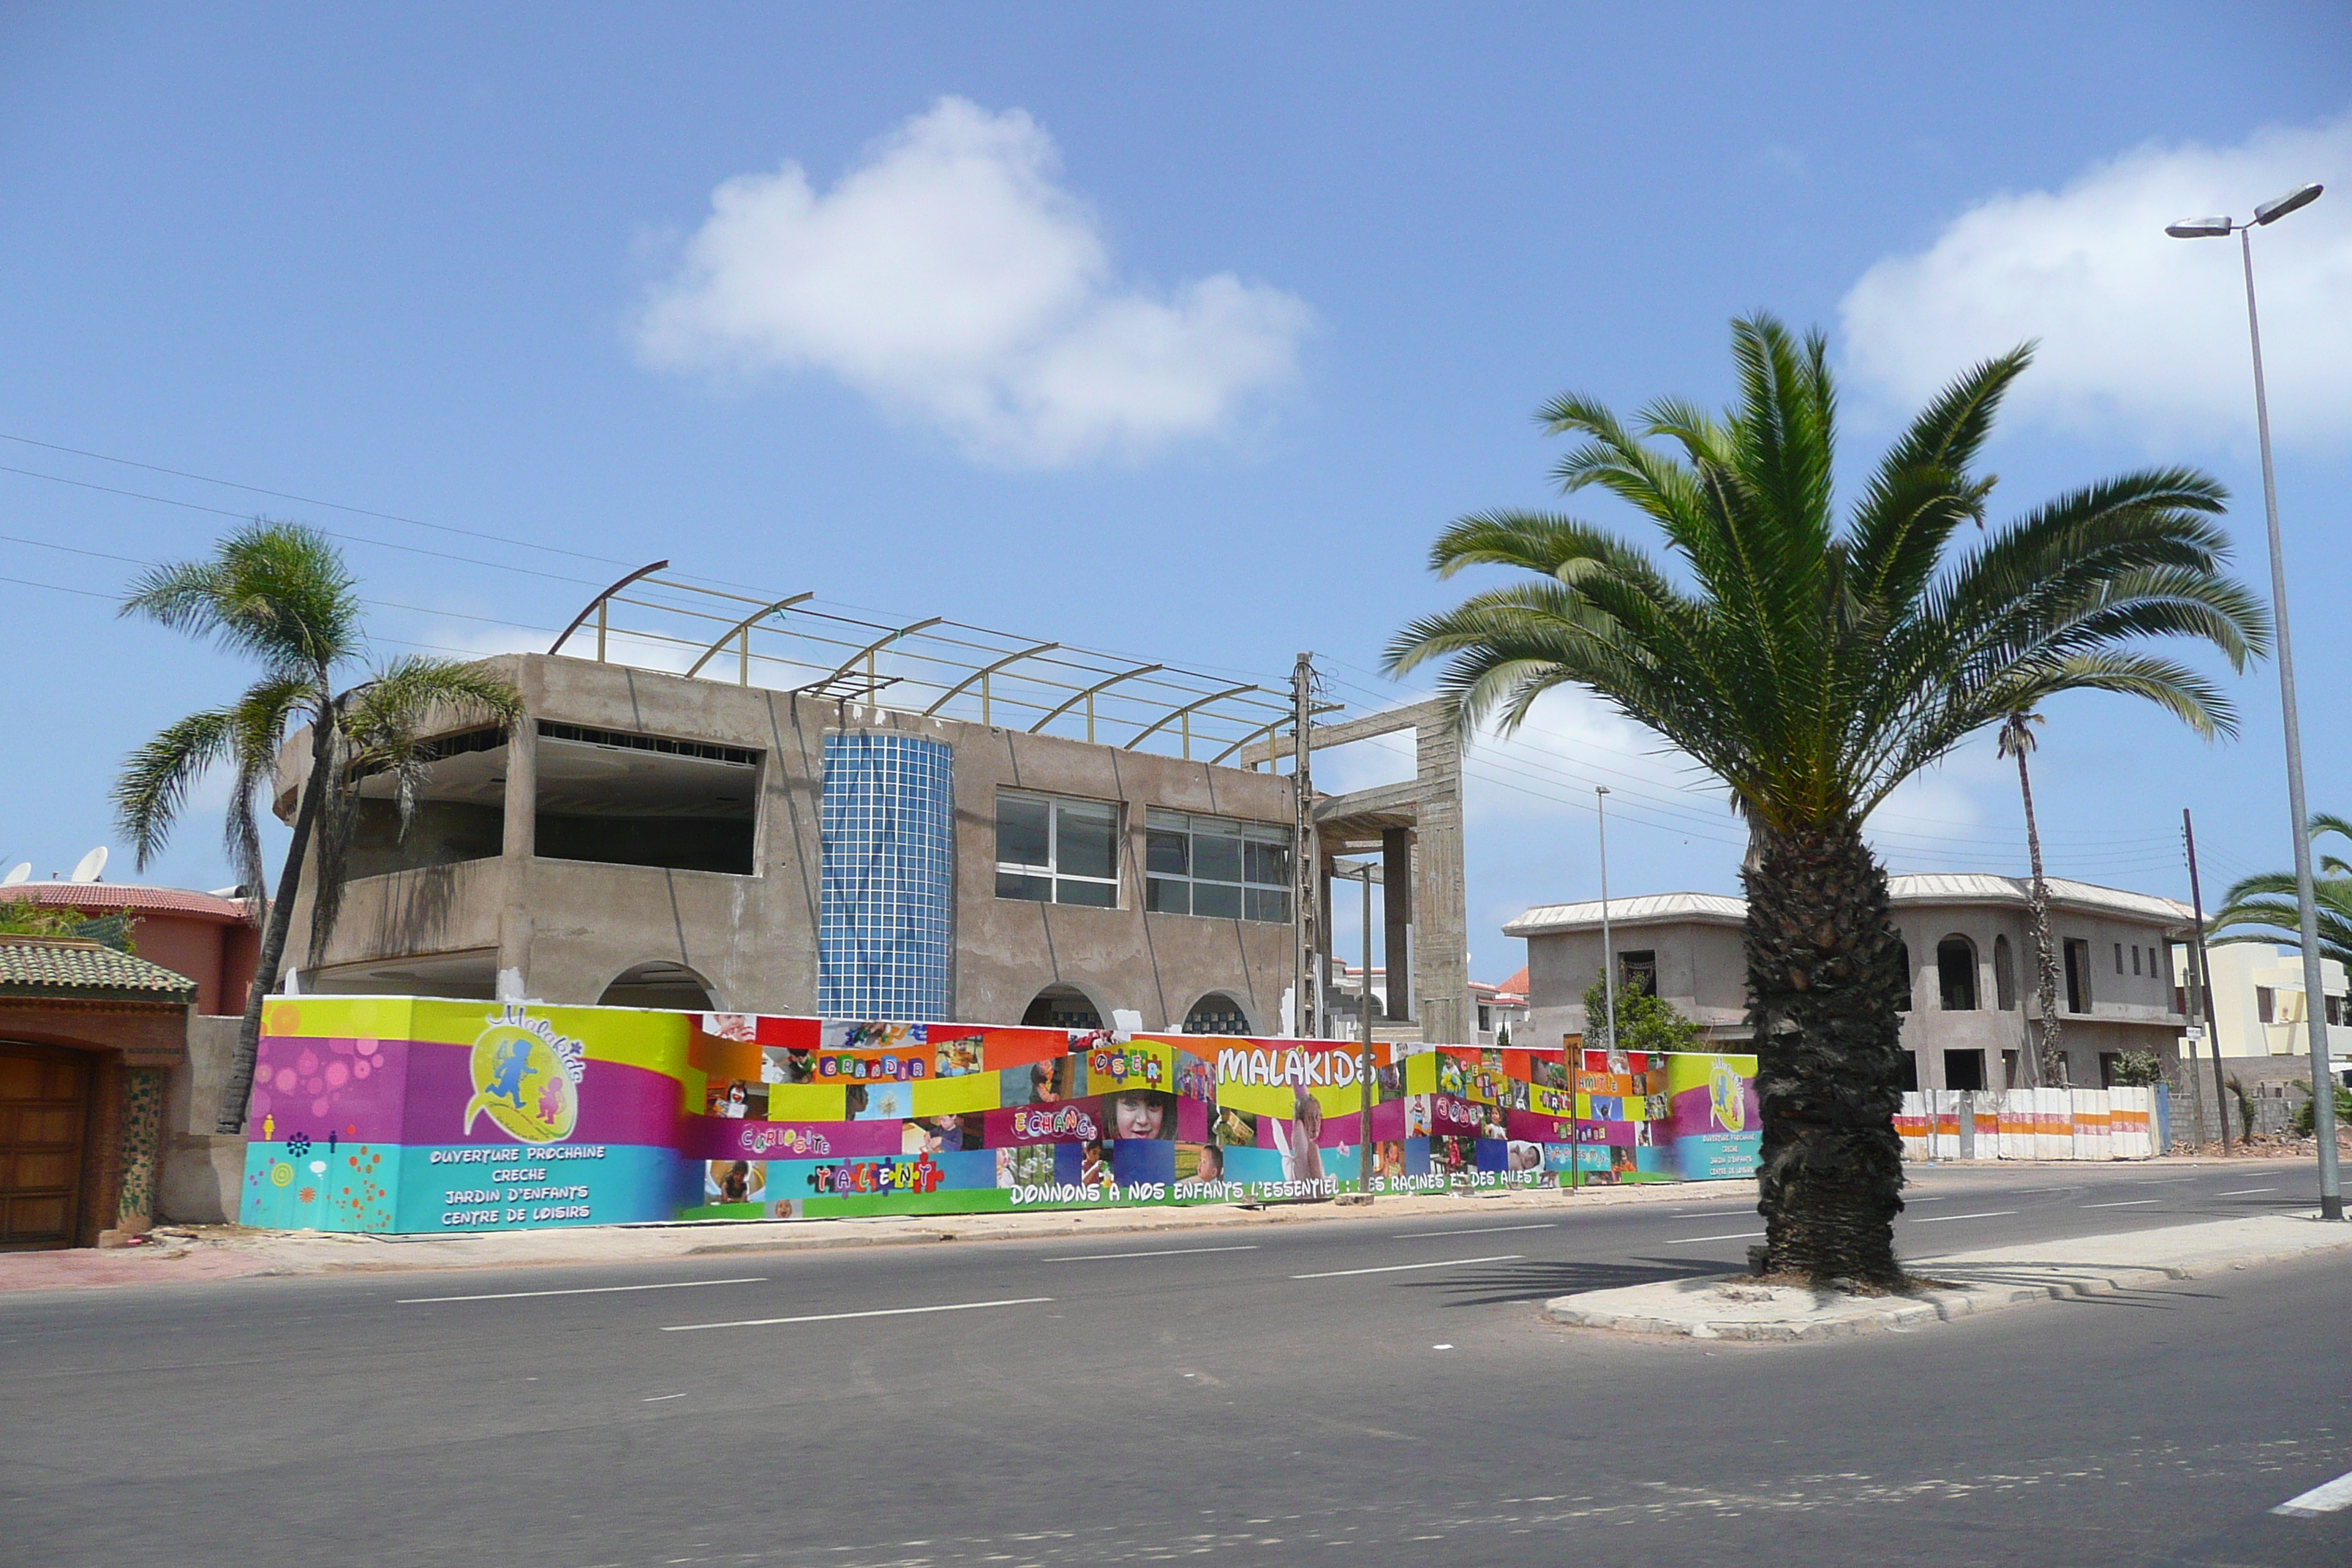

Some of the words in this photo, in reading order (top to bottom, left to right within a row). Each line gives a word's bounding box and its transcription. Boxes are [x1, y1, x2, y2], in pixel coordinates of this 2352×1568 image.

[487, 1005, 583, 1082] Malakids
[822, 1058, 924, 1079] GRANDIR
[1095, 1054, 1158, 1079] OSER
[1217, 1047, 1377, 1088] MALAKIDS
[1014, 1109, 1098, 1140] ECHANGE
[430, 1148, 520, 1164] OUVERTURE
[527, 1145, 606, 1161] PROCHAINE
[741, 1128, 831, 1155] CURIOSITE
[491, 1168, 547, 1183] CRECHE
[817, 1163, 932, 1191] TALENT
[1010, 1182, 1101, 1205] DONNONS
[1109, 1182, 1120, 1202] A
[1128, 1180, 1166, 1202] NOS
[1173, 1180, 1244, 1202] ENFANTS
[1251, 1177, 1340, 1199] L'ESSENTIEL
[1391, 1172, 1445, 1192] RACINES
[1470, 1171, 1496, 1187] DES
[1500, 1169, 1533, 1186] AILES
[445, 1188, 501, 1205] JARDIN
[507, 1186, 589, 1202] D'ENFANTS
[442, 1210, 500, 1226] CENTRE
[506, 1208, 527, 1222] DE
[533, 1205, 591, 1221] LOISIRS
